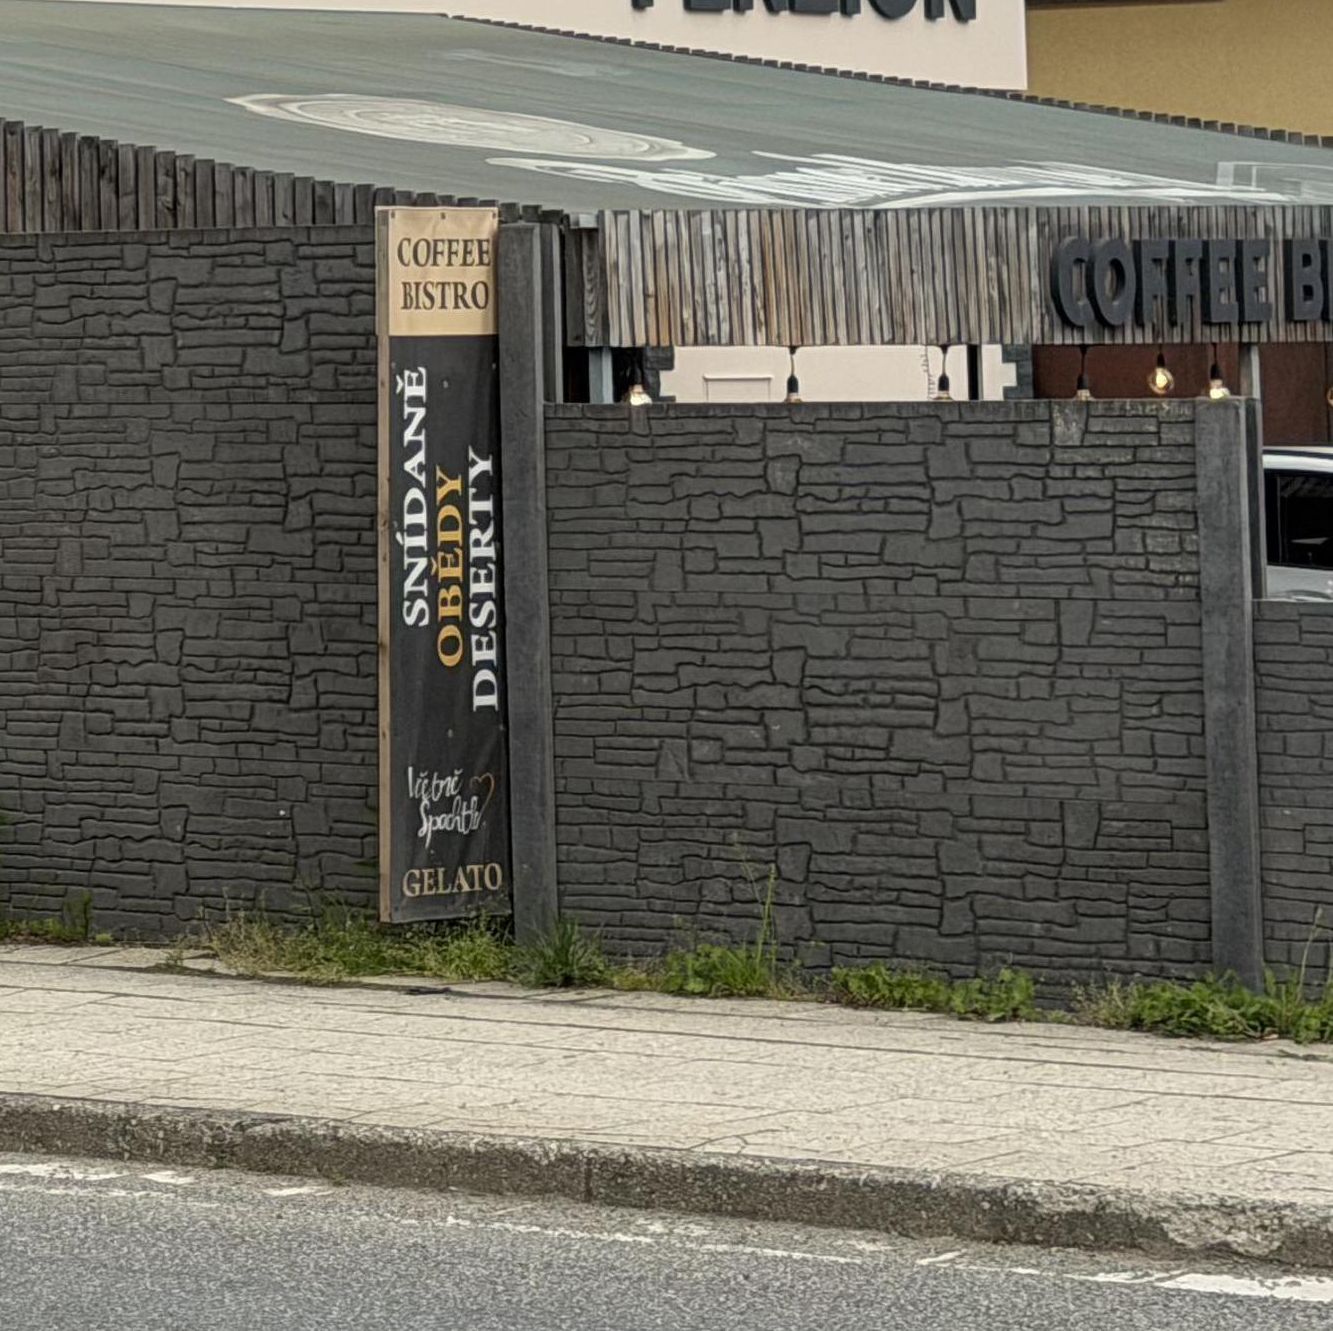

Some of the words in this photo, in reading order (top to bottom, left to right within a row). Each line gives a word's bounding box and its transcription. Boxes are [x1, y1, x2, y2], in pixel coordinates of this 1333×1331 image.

[397, 238, 491, 267] COFFEE
[401, 281, 489, 311] BISTRO
[1050, 237, 1272, 329] COFFEE
[396, 367, 429, 628] SNÍDANĚ
[431, 465, 463, 668] OBĚDY
[468, 445, 499, 712] DESERTY
[402, 862, 503, 897] GELATO
